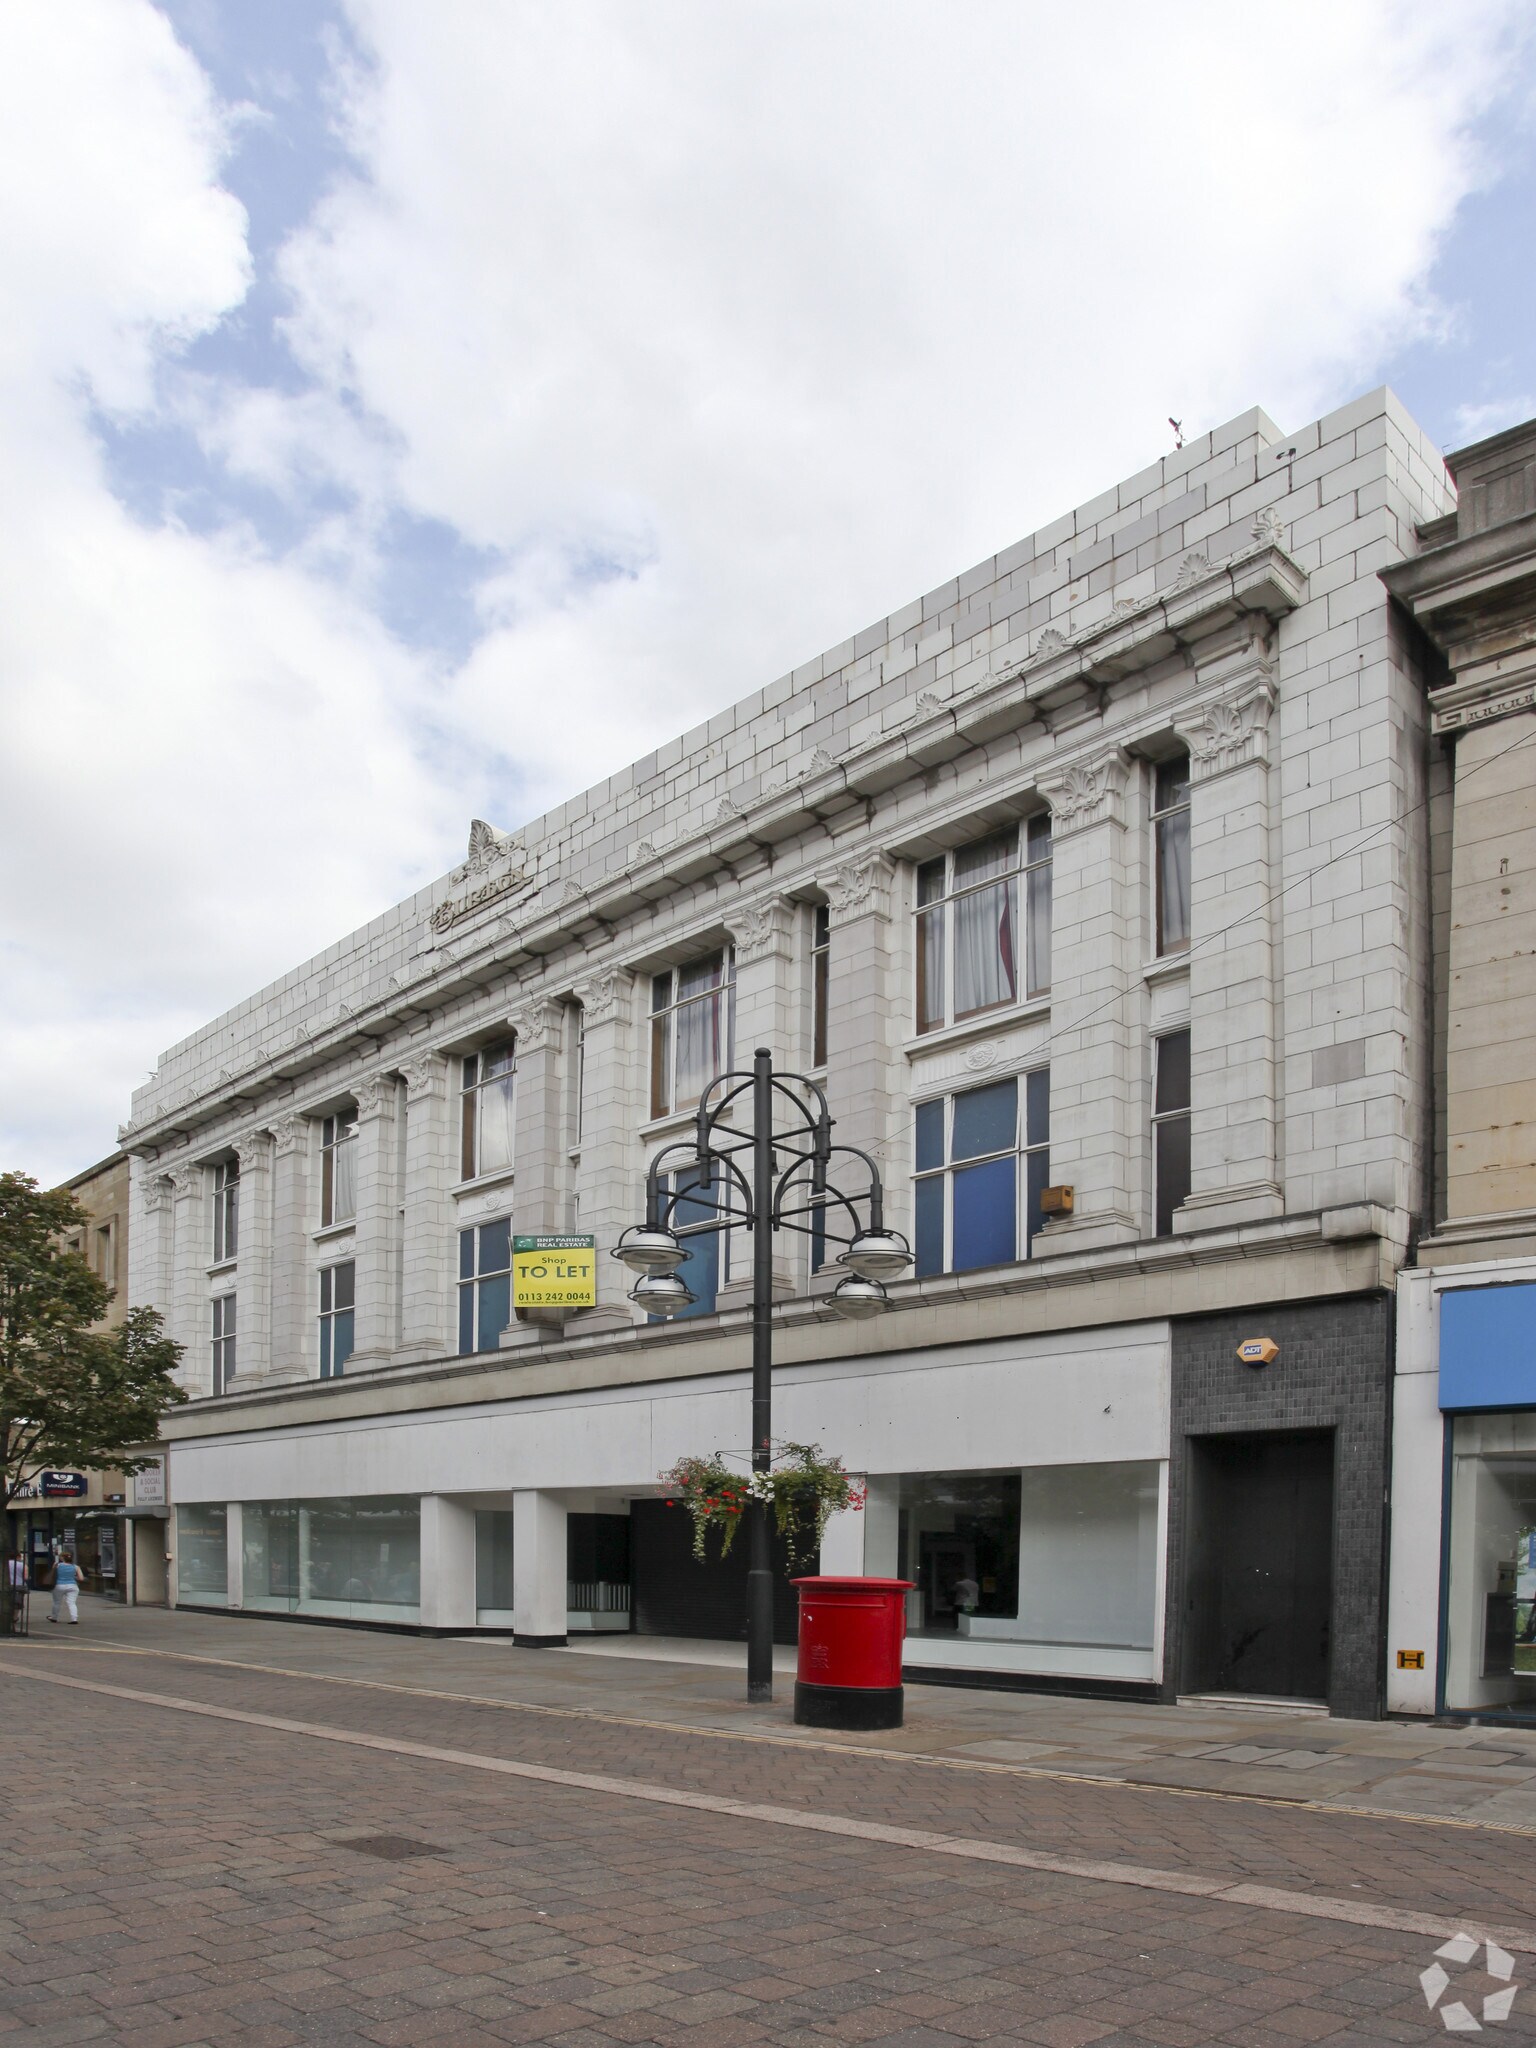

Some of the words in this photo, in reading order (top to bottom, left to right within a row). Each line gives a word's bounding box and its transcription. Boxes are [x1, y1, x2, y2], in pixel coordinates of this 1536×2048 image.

[518, 1266, 548, 1278] TO
[557, 1266, 590, 1277] LET
[518, 1293, 542, 1301] 0113
[545, 1293, 563, 1301] 242
[567, 1293, 590, 1301] 0044
[1244, 1346, 1261, 1354] ADT
[143, 1486, 157, 1494] CLUB
